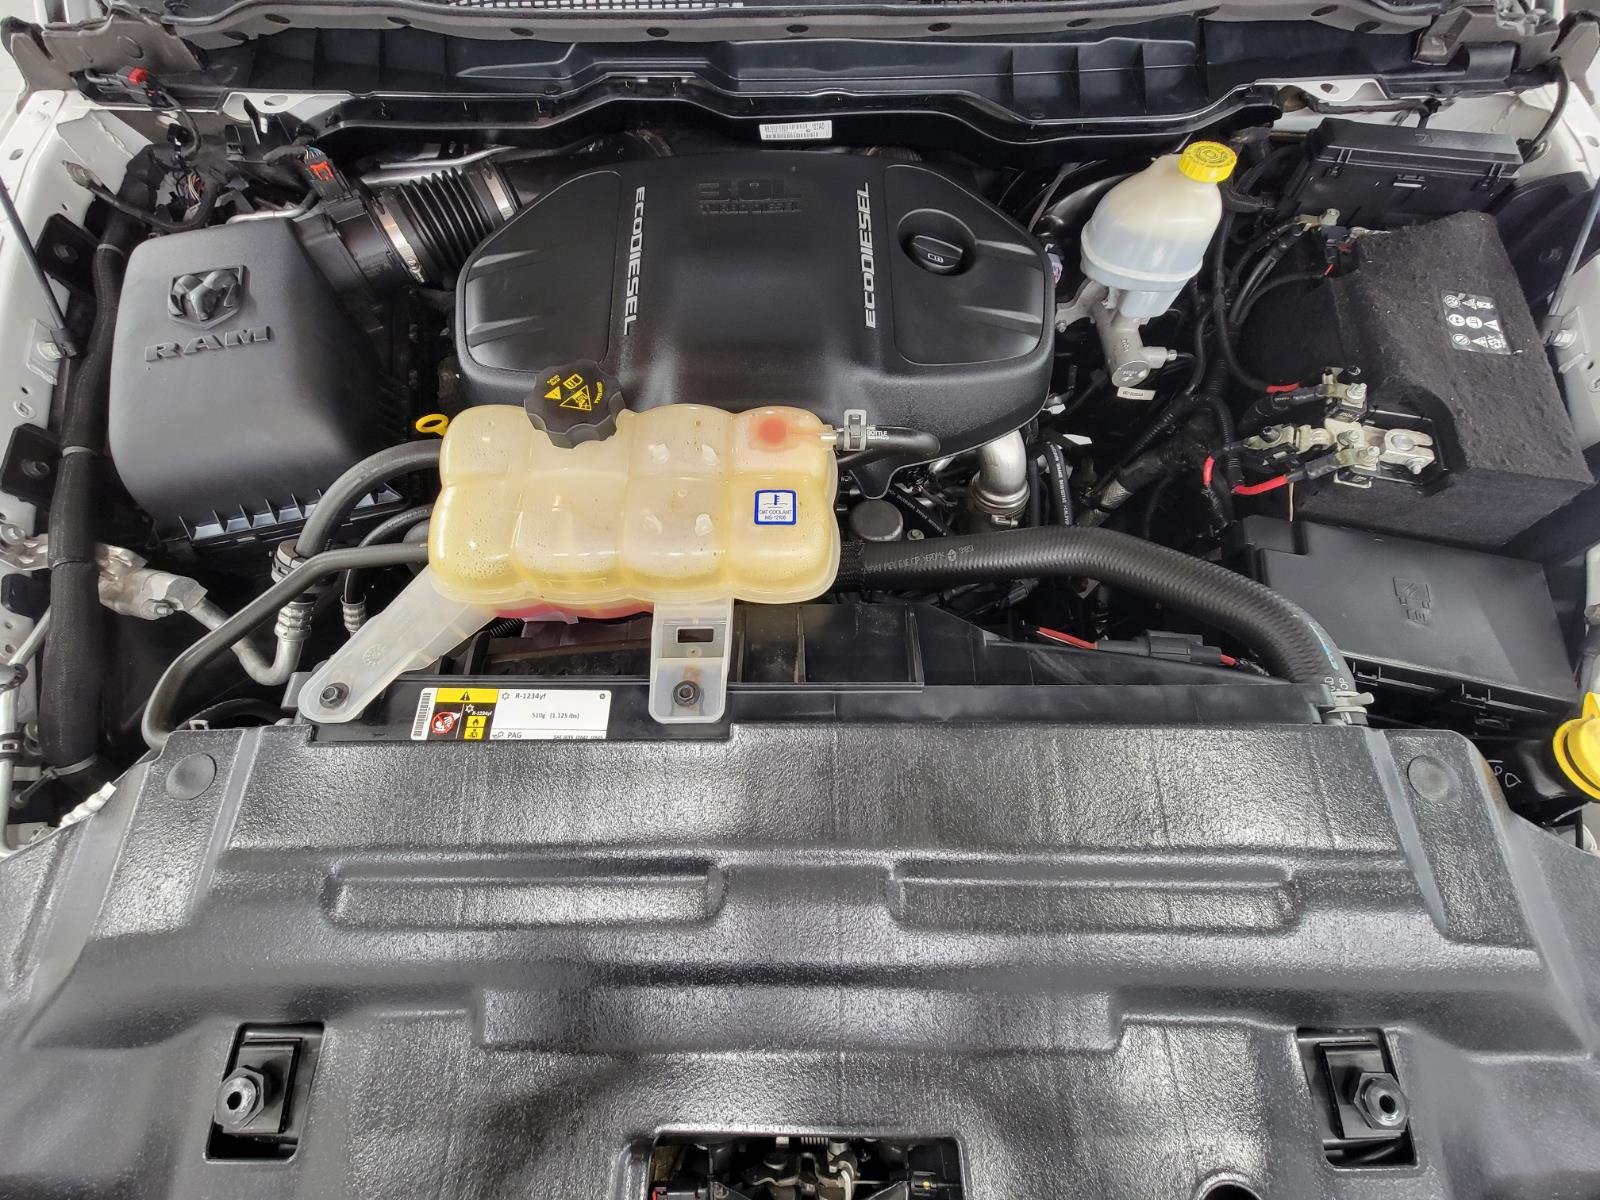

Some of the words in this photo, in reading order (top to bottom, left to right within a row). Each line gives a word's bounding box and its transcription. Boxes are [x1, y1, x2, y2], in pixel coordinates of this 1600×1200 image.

[624, 186, 646, 336] ECODIESEL
[857, 182, 876, 329] ECODIESEL
[144, 326, 272, 362] RAM
[514, 692, 547, 701] R-1234yf
[507, 731, 523, 739] PAG
